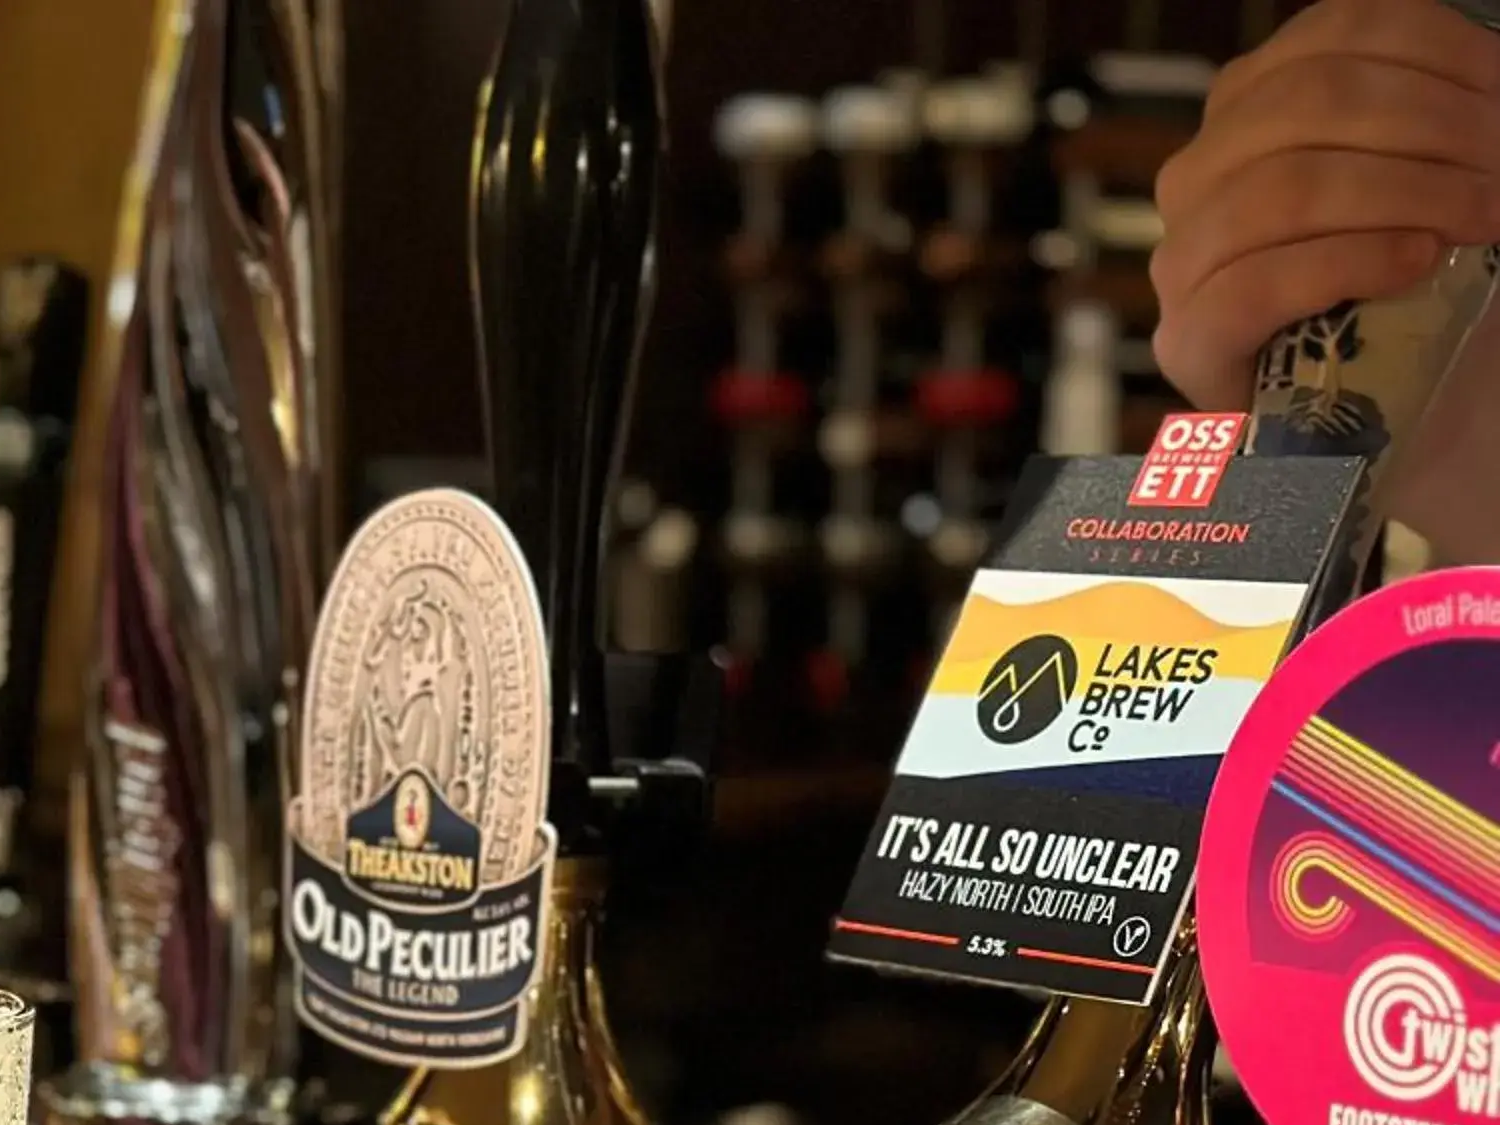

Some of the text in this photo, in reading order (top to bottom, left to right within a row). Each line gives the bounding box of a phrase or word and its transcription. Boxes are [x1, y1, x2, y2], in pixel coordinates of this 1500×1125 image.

[1161, 419, 1237, 450] OSS
[1136, 466, 1217, 500] ETT
[1067, 518, 1251, 543] COLLABORATION
[1403, 593, 1453, 637] Loral
[1094, 643, 1219, 685] LAKES
[1079, 681, 1195, 723] BREW
[348, 837, 475, 891] THEAKSTON
[877, 815, 1181, 894] IT'S ALL SO UNCLEAR
[899, 868, 954, 902] HAZY
[949, 876, 1015, 913] NORTH
[1022, 885, 1088, 922] SOUTH
[1081, 894, 1118, 926] IPA
[293, 878, 534, 981] OLD PECULIER
[966, 934, 1008, 957] 5.3%
[387, 978, 460, 1007] LEGEND
